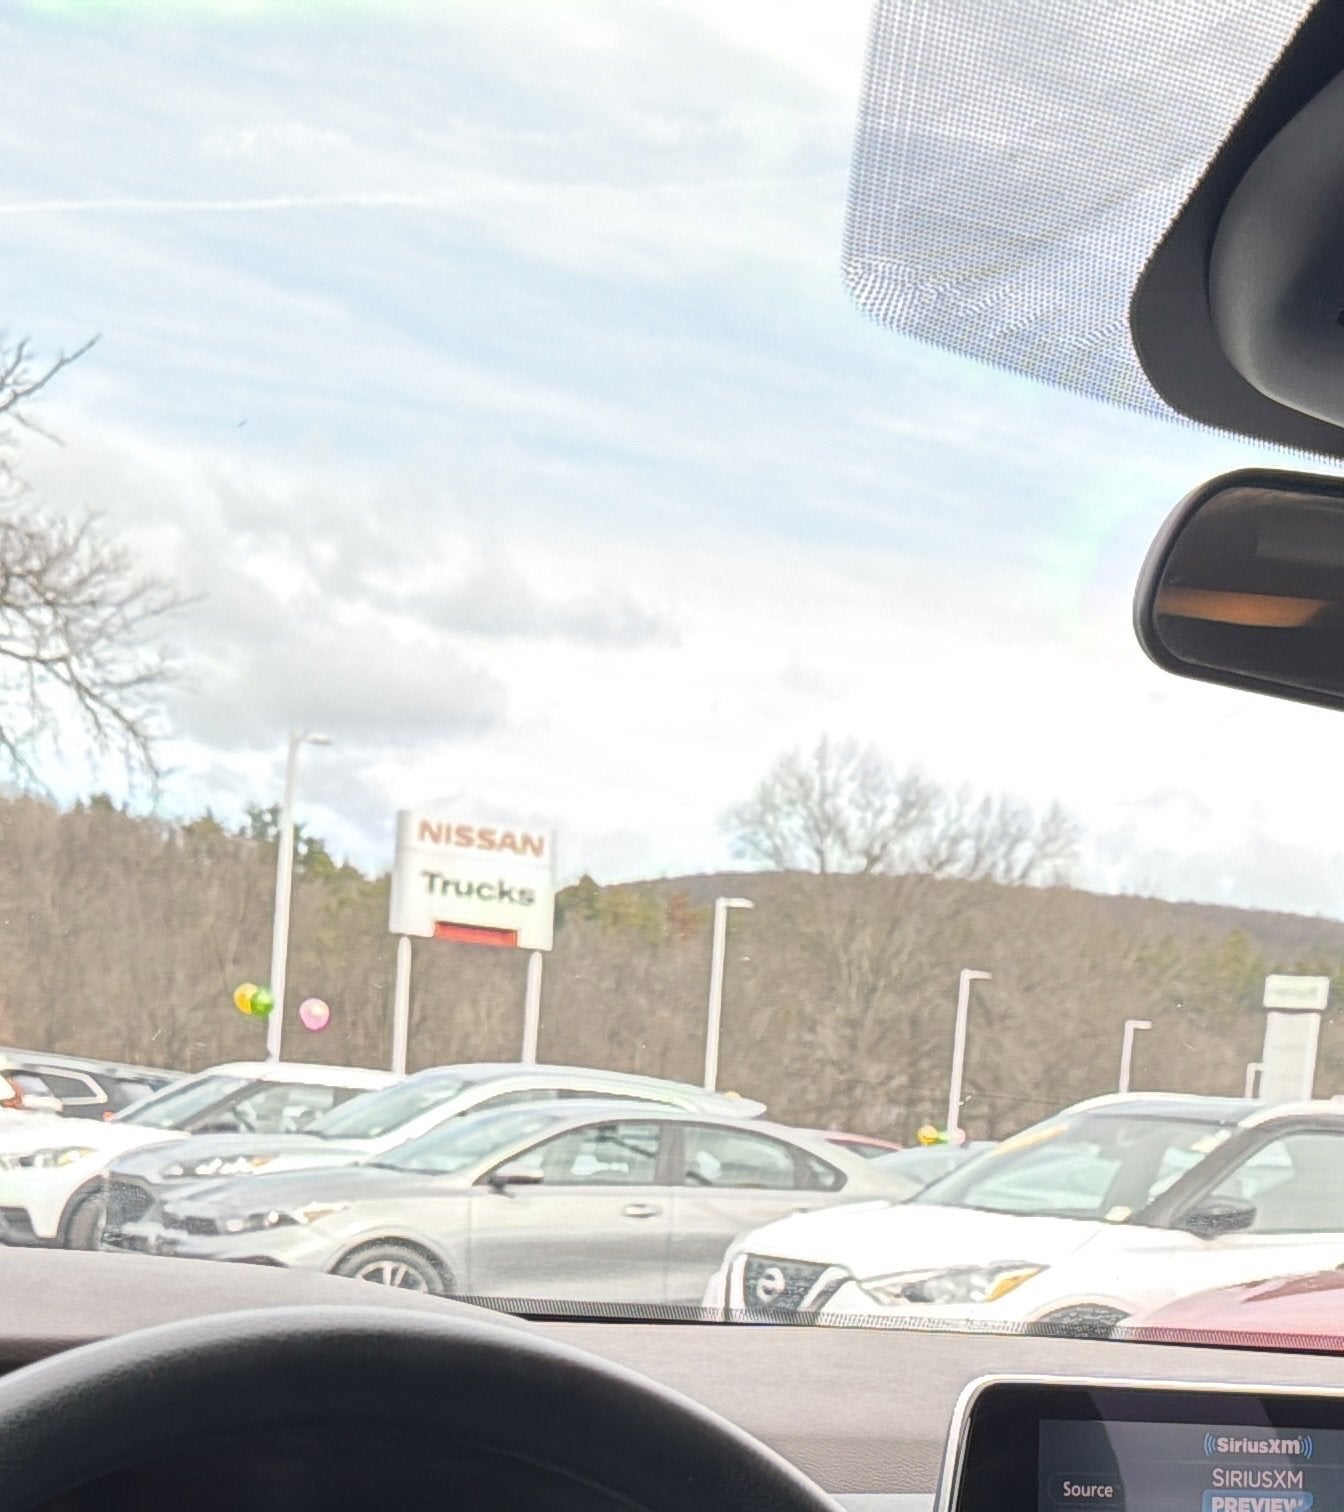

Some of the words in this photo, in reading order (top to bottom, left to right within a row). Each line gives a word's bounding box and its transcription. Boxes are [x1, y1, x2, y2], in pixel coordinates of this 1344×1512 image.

[417, 819, 544, 857] NISSAN
[420, 869, 537, 907] Trucks
[1063, 1481, 1113, 1498] Source
[1212, 1467, 1304, 1490] SIRIUSXM
